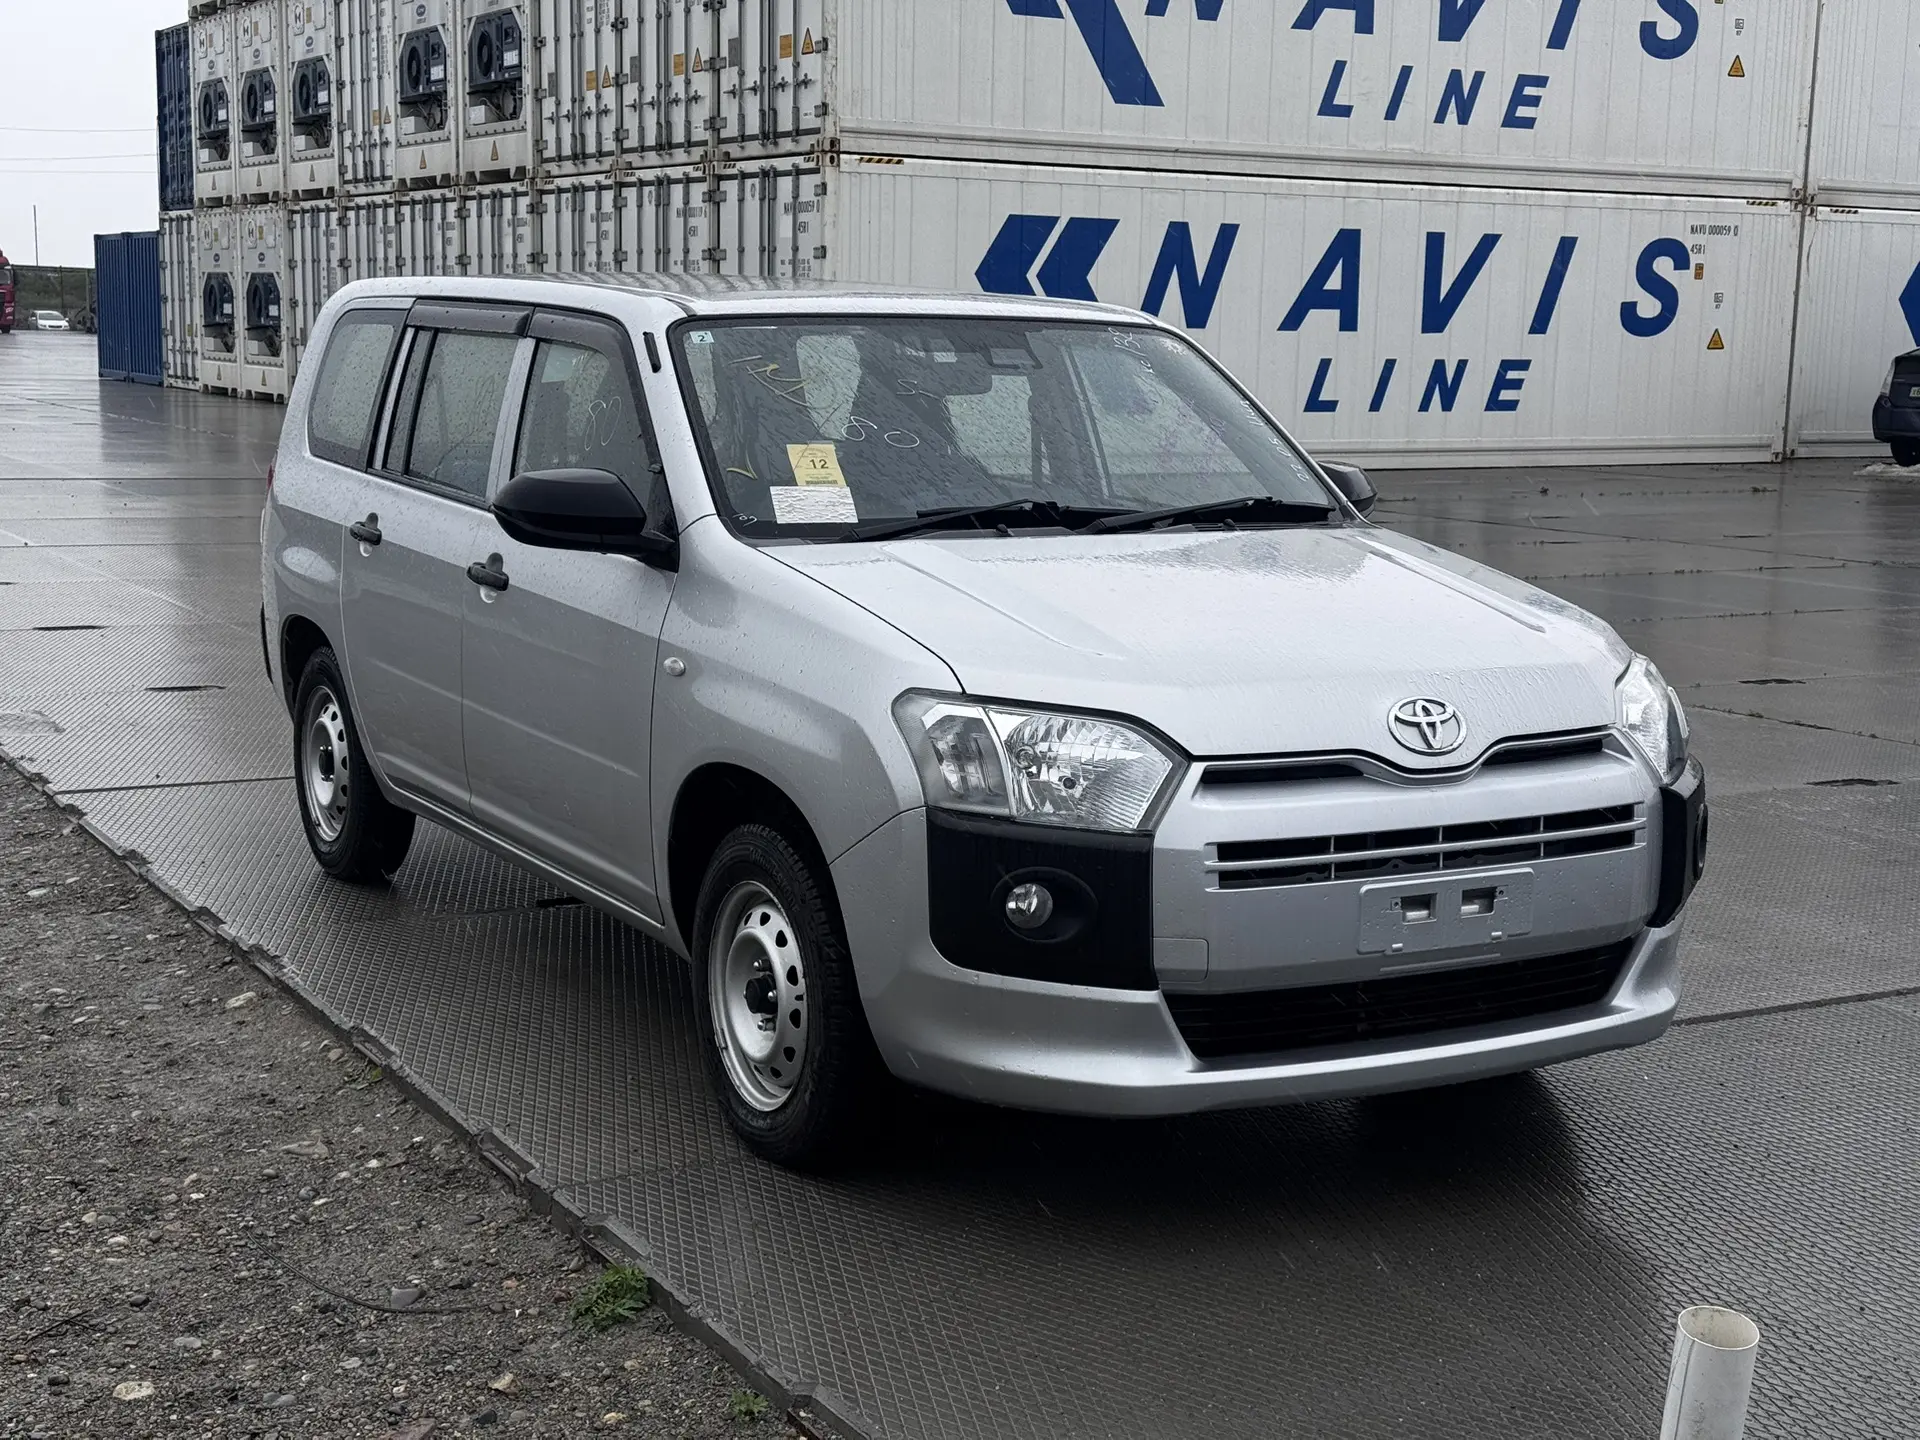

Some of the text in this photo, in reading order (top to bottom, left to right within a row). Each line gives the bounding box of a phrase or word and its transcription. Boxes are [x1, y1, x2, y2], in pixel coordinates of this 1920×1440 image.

[1317, 60, 1550, 129] LINE
[1690, 224, 1706, 235] NAVU
[1708, 225, 1731, 236] 000059
[1141, 220, 1690, 337] NAVIS
[698, 334, 706, 342] 2
[1304, 358, 1532, 412] LINE
[809, 458, 829, 469] 12
